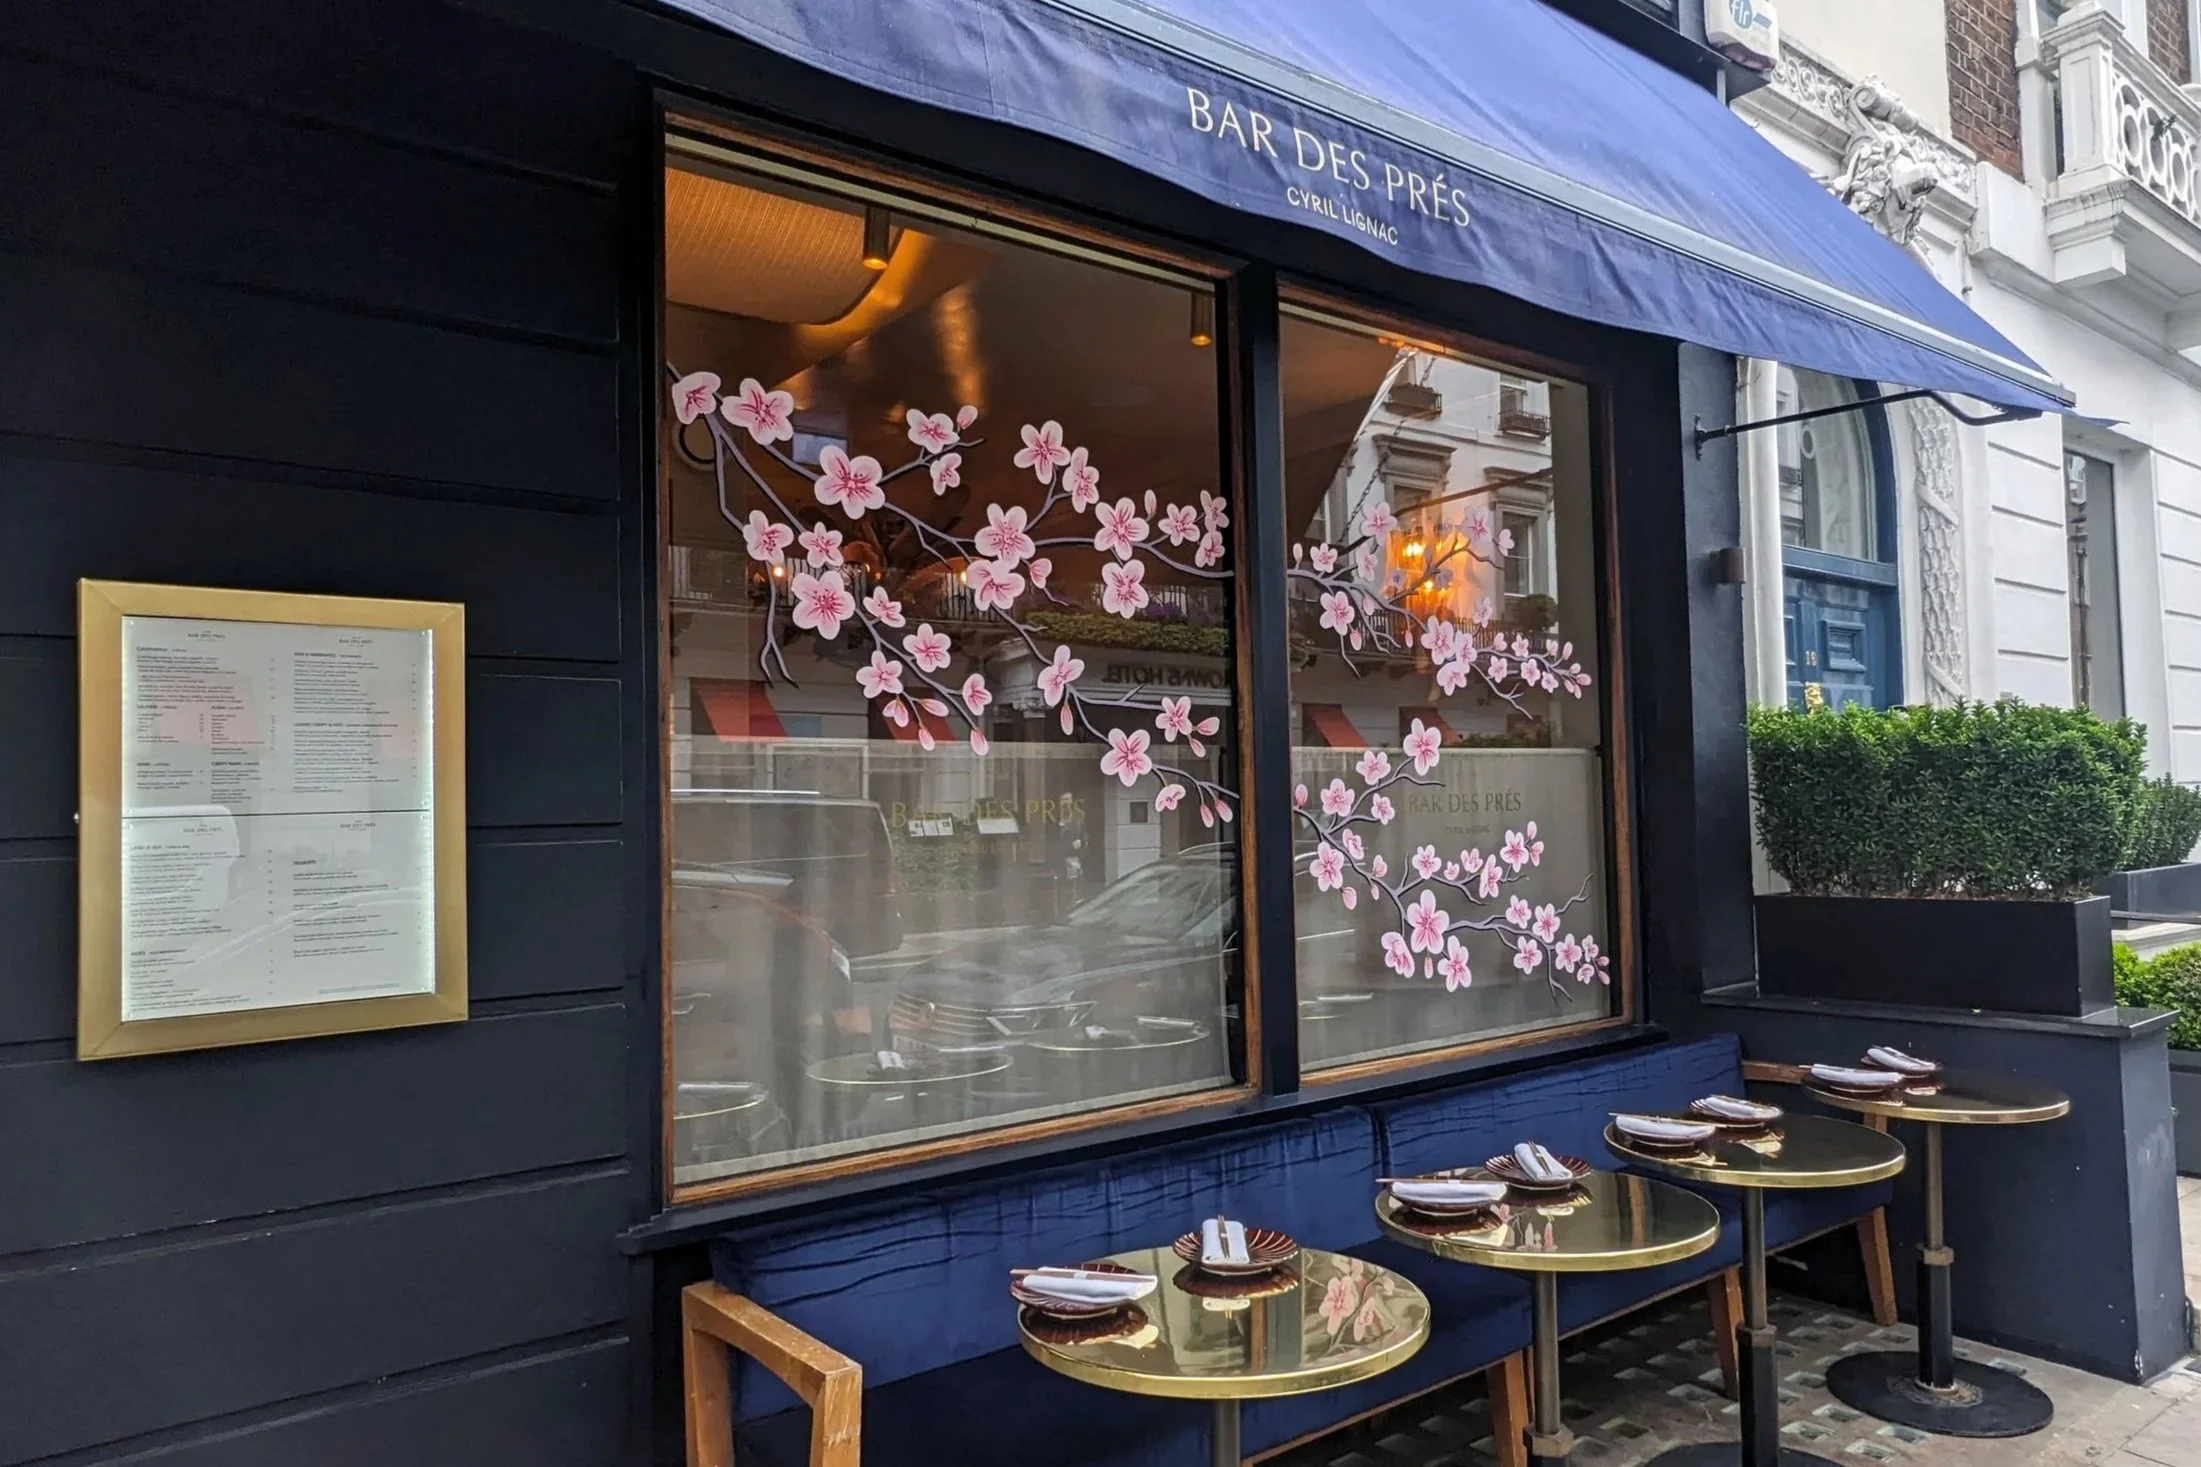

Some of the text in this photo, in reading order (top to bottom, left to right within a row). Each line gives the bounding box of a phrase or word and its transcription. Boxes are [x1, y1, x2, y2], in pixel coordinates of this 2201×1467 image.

[1186, 87, 1470, 228] BAR DES PRÉS
[1286, 187, 1399, 246] CYRIL LIGNAC
[1448, 792, 1480, 813] DES
[1485, 788, 1522, 812] PRÉS
